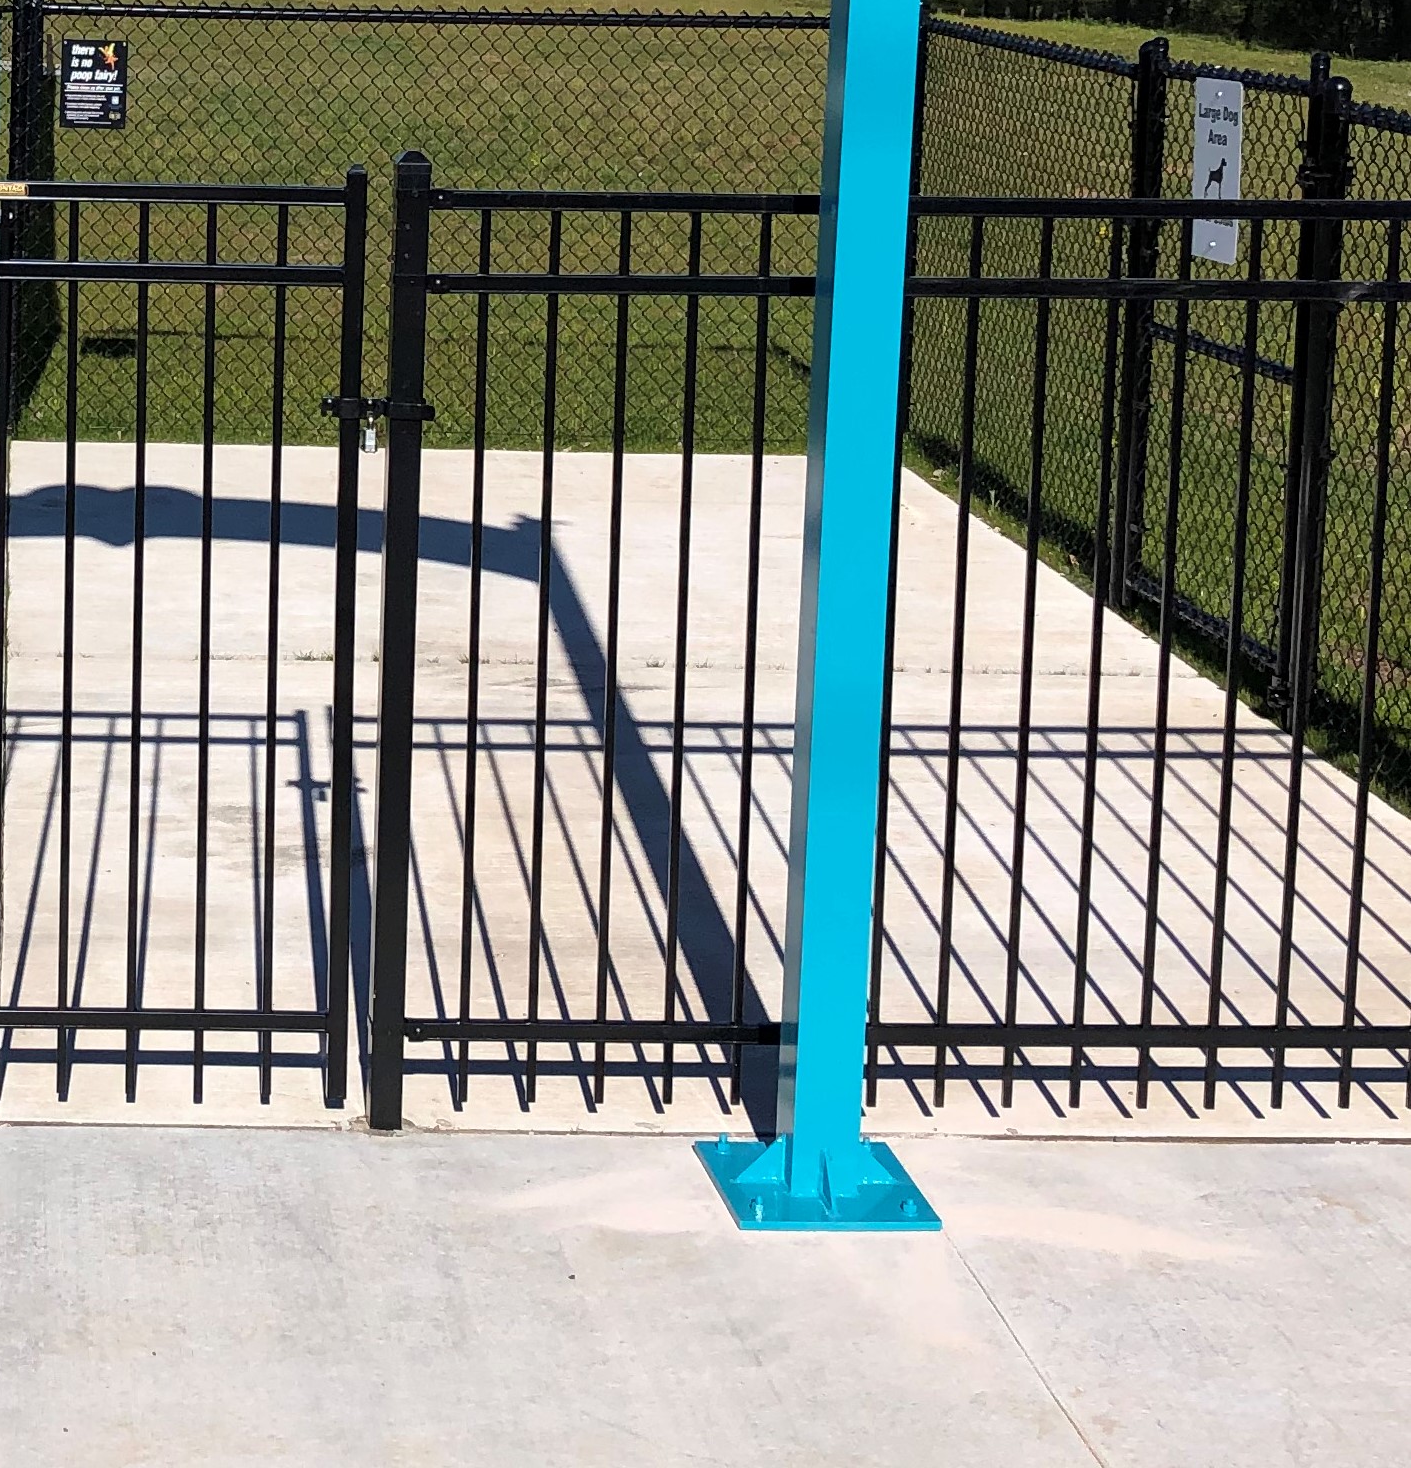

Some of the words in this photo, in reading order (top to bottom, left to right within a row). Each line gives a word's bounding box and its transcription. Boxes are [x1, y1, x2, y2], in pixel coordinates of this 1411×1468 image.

[72, 44, 95, 55] there
[71, 56, 79, 67] is
[81, 59, 93, 67] no
[70, 71, 92, 82] poop
[94, 70, 118, 82] fairy!
[1199, 103, 1221, 123] Large
[1223, 106, 1238, 126] Dog
[1208, 129, 1228, 146] Area
